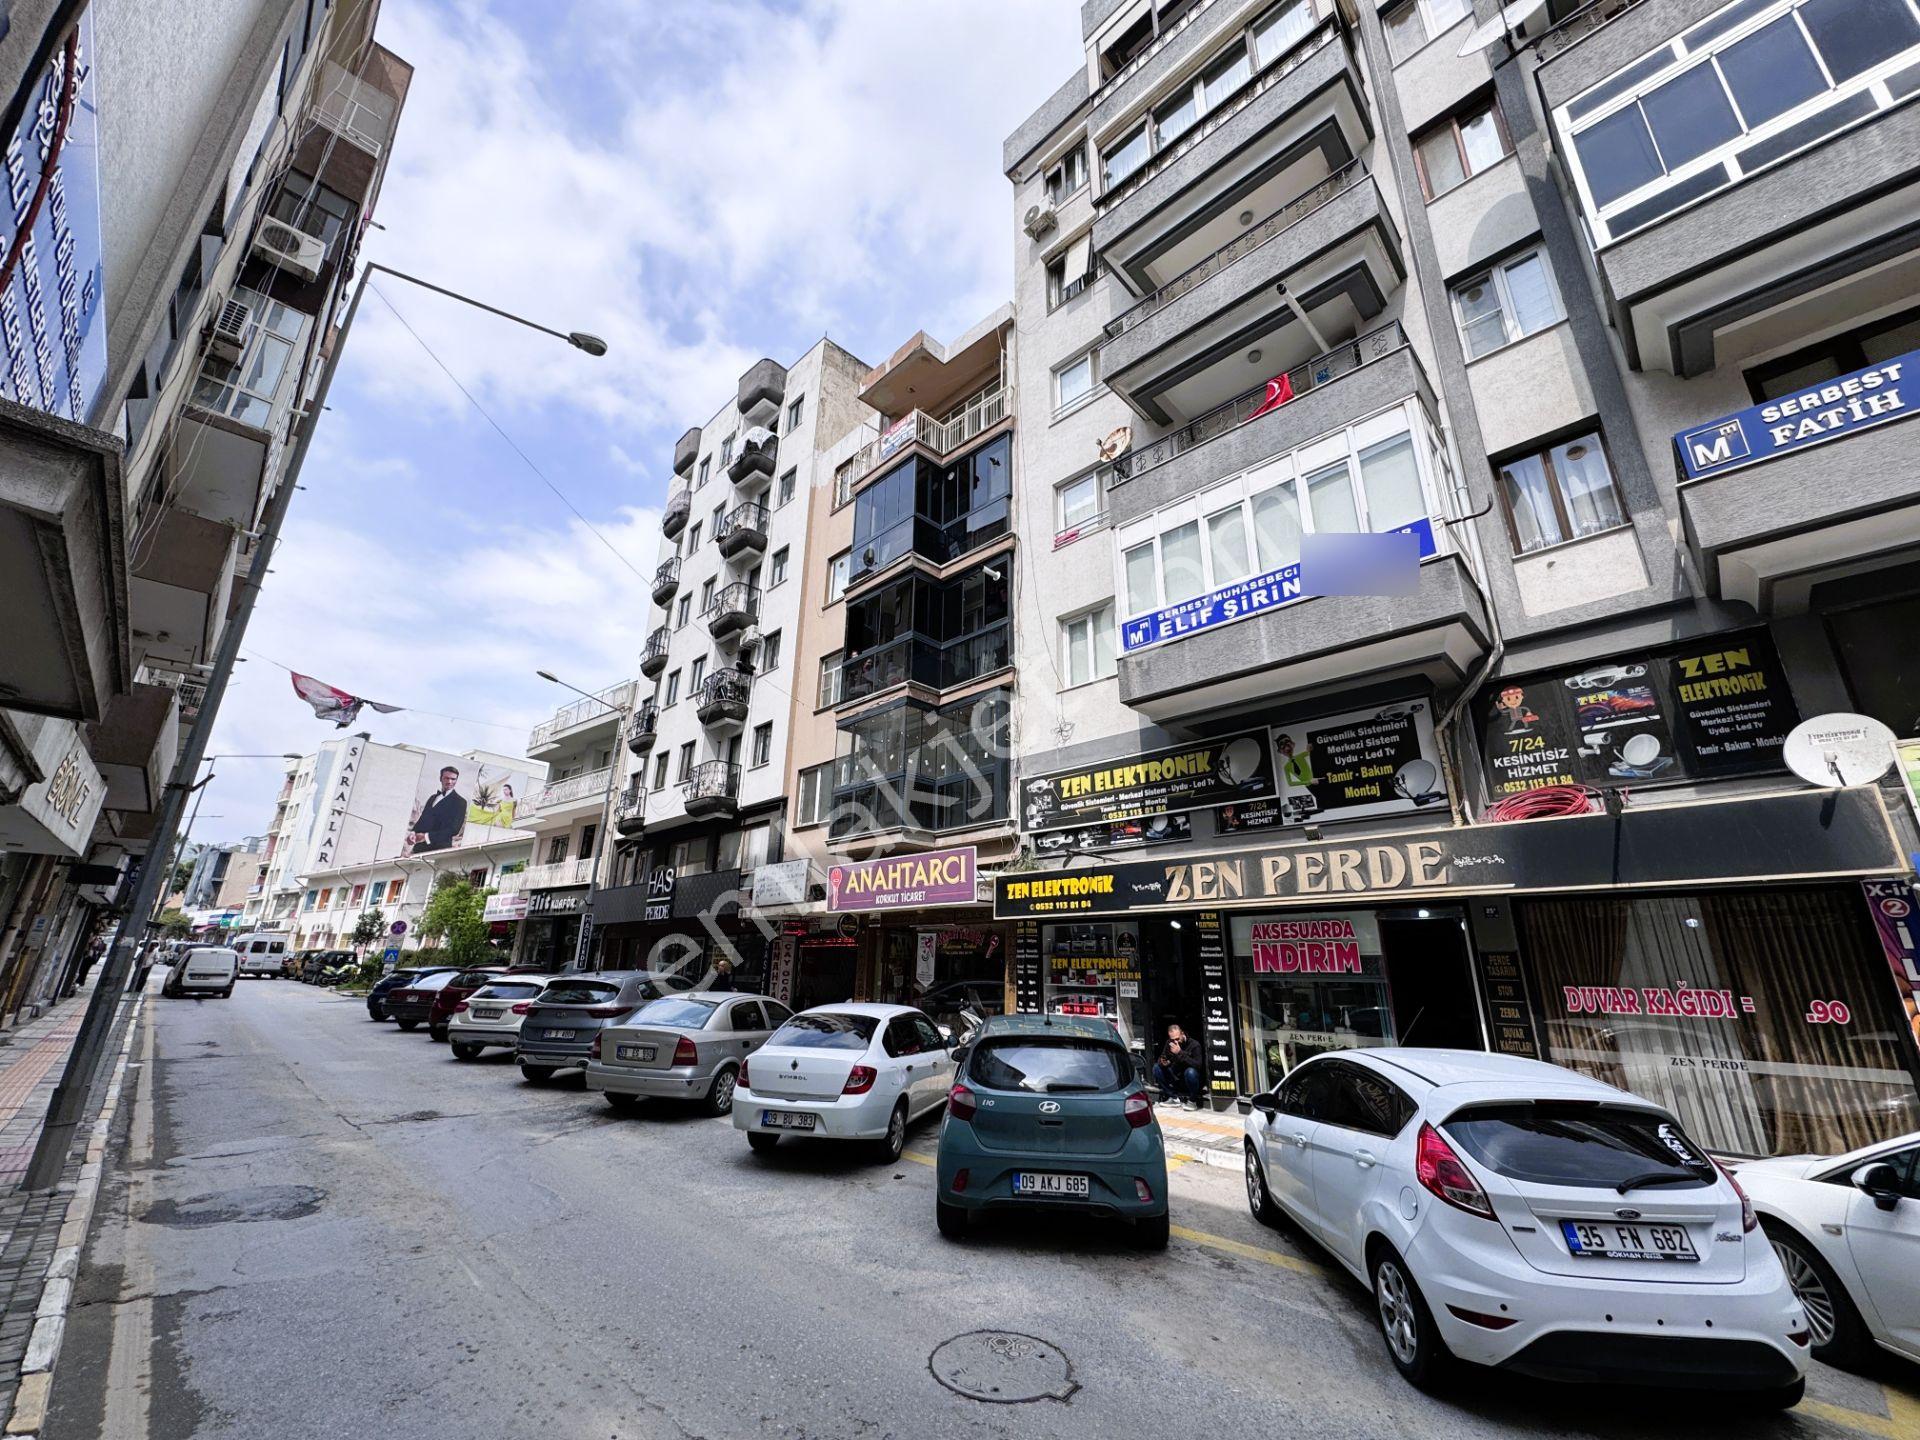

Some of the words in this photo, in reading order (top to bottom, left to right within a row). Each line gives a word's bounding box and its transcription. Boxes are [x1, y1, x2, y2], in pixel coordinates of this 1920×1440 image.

[50, 165, 67, 240] AYDIN
[1761, 363, 1903, 424] SERBEST
[1769, 388, 1905, 448] FATİH
[1157, 596, 1210, 621] SERBEST
[1159, 608, 1213, 637] ELİF
[1223, 576, 1300, 618] ŞİRİN
[1679, 648, 1751, 678] ZEN
[1678, 671, 1767, 703] ELEKTRONİK
[1689, 706, 1726, 719] Güvenlik
[1727, 700, 1772, 714] Sistemleri
[1700, 716, 1734, 728] Merkezi
[1735, 711, 1766, 722] Sistem
[1316, 731, 1356, 745] Güvenlik
[1358, 720, 1408, 737] Sistemleri
[1327, 742, 1364, 754] Merkezi
[1366, 735, 1400, 748] Sistem
[1509, 736, 1545, 753] 7/24
[1696, 744, 1719, 756] Tamir
[1724, 740, 1750, 752] Bakım
[1335, 754, 1358, 766] Uydu
[1365, 750, 1383, 760] Led
[1384, 748, 1396, 757] Tv
[1493, 747, 1570, 769] KESİNTİSİZ
[1061, 775, 1092, 798] ZEN
[1094, 751, 1213, 794] ELEKTRONİK
[1327, 769, 1354, 784] Tamir
[1361, 763, 1393, 779] Bakım
[1507, 763, 1559, 779] HİZMET
[1144, 787, 1166, 797] Sistem
[1345, 782, 1380, 799] Montaj
[1504, 780, 1527, 793] 0532
[1529, 777, 1545, 790] 113
[1546, 776, 1558, 786] 81
[318, 746, 358, 863] SARANLAR
[1250, 802, 1267, 811] 7/24
[1108, 811, 1128, 819] 0532
[1247, 817, 1273, 826] HİZMET
[845, 855, 967, 894] ANAHTARCI
[1165, 857, 1244, 902] ZEN
[1261, 839, 1447, 896] PERDE
[647, 868, 674, 895] HAS
[1007, 882, 1029, 900] ZEN
[1031, 875, 1114, 898] ELEKTRONİK
[875, 893, 900, 905] KORKUT
[900, 890, 926, 903] TİCARET
[1035, 901, 1054, 910] 0532
[1056, 901, 1068, 909] 113
[645, 904, 670, 920] PERDE
[1251, 919, 1356, 941] AKSESUARDA
[1051, 958, 1068, 969] ZEN
[1252, 941, 1363, 974] İNDİRİM
[1563, 986, 1642, 1015] DUVAR
[1642, 980, 1738, 1018] KAĞIDI
[1500, 1008, 1520, 1018] ZEBRA
[1670, 1056, 1697, 1068] ZEN
[1702, 1058, 1750, 1072] PERDE
[779, 1073, 808, 1081] SYMBOL
[798, 1115, 813, 1126] 383
[1021, 1175, 1035, 1189] 09
[1040, 1175, 1061, 1190] AKJ
[1065, 1177, 1087, 1192] 685
[1578, 1226, 1605, 1248] 35
[1615, 1227, 1645, 1249] FN
[1651, 1229, 1690, 1252] 682
